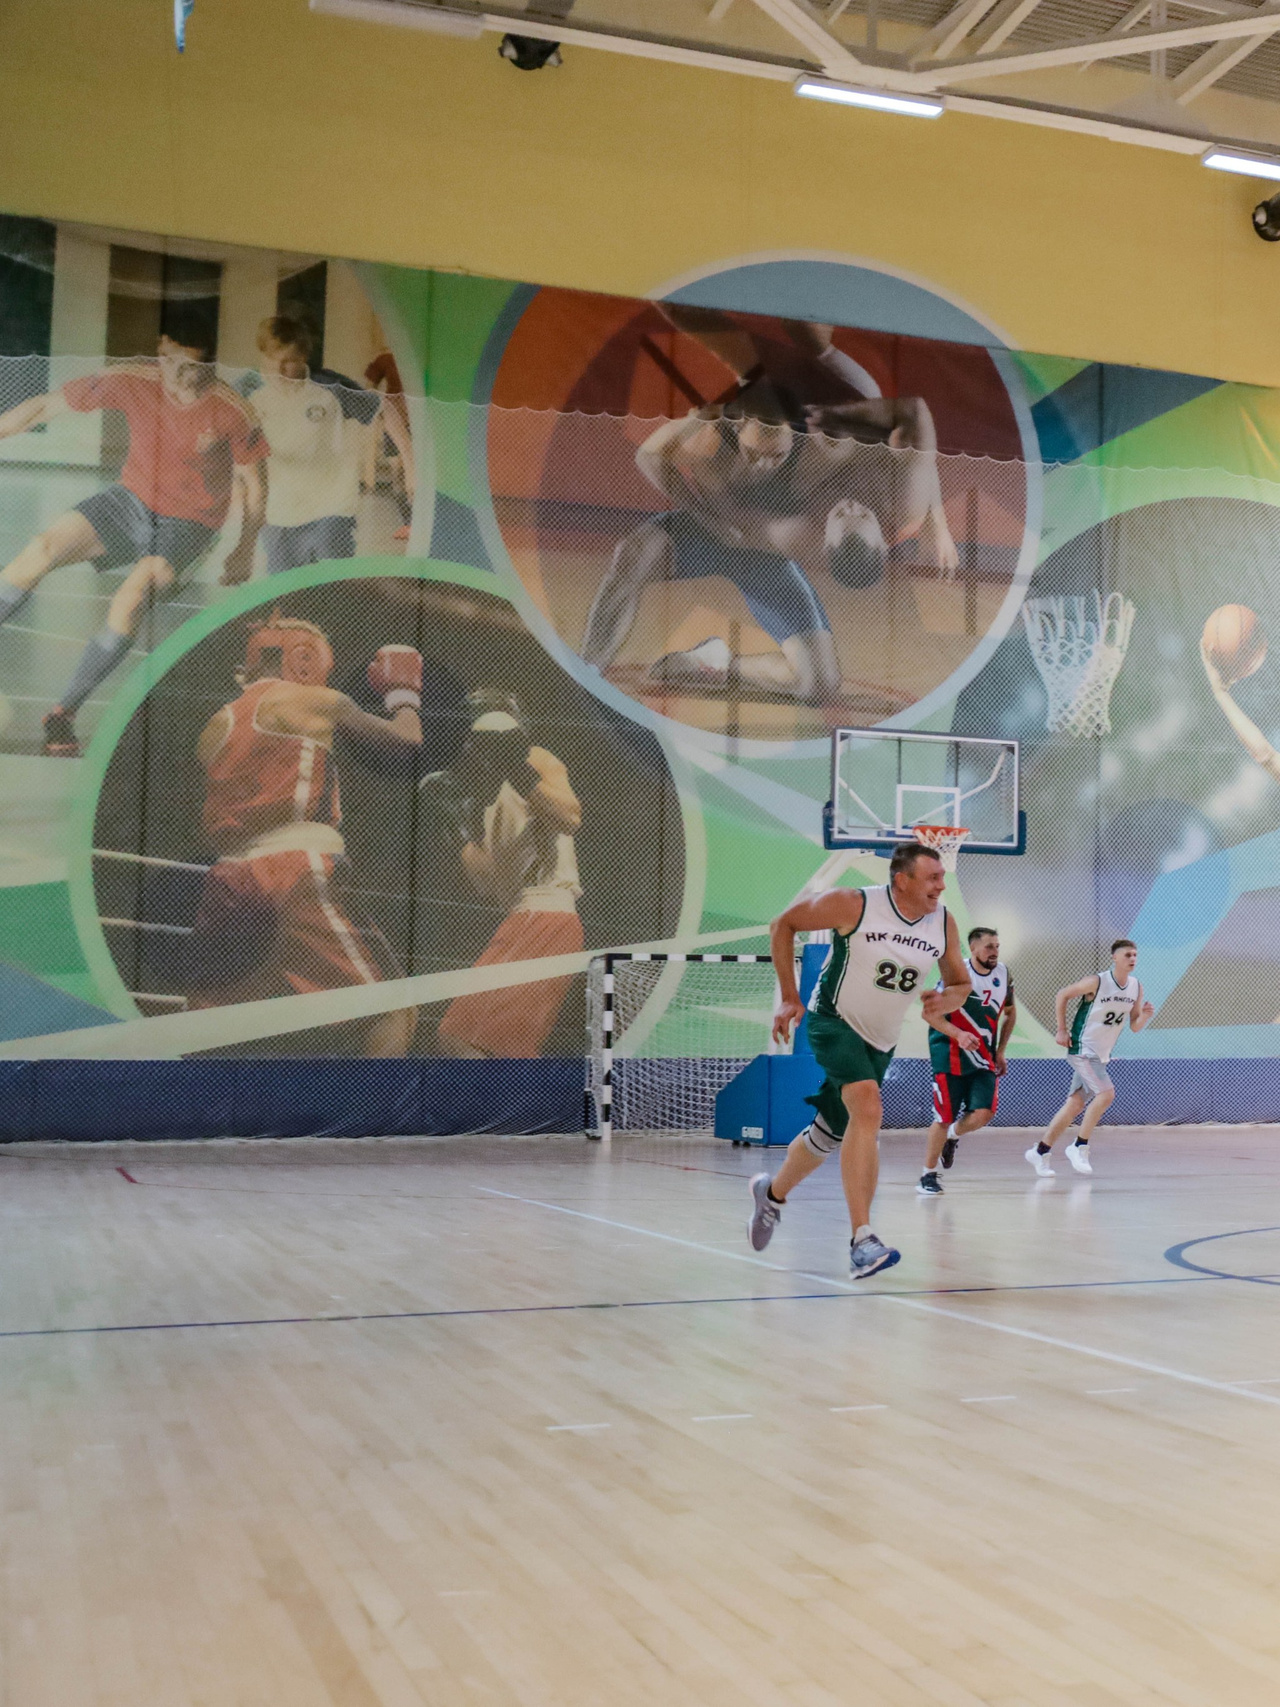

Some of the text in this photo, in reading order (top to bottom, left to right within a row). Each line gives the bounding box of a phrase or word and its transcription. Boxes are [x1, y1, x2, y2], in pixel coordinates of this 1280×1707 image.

[865, 932, 888, 942] НК
[875, 960, 920, 993] 28
[982, 989, 992, 1006] 7
[1103, 1011, 1125, 1025] 24
